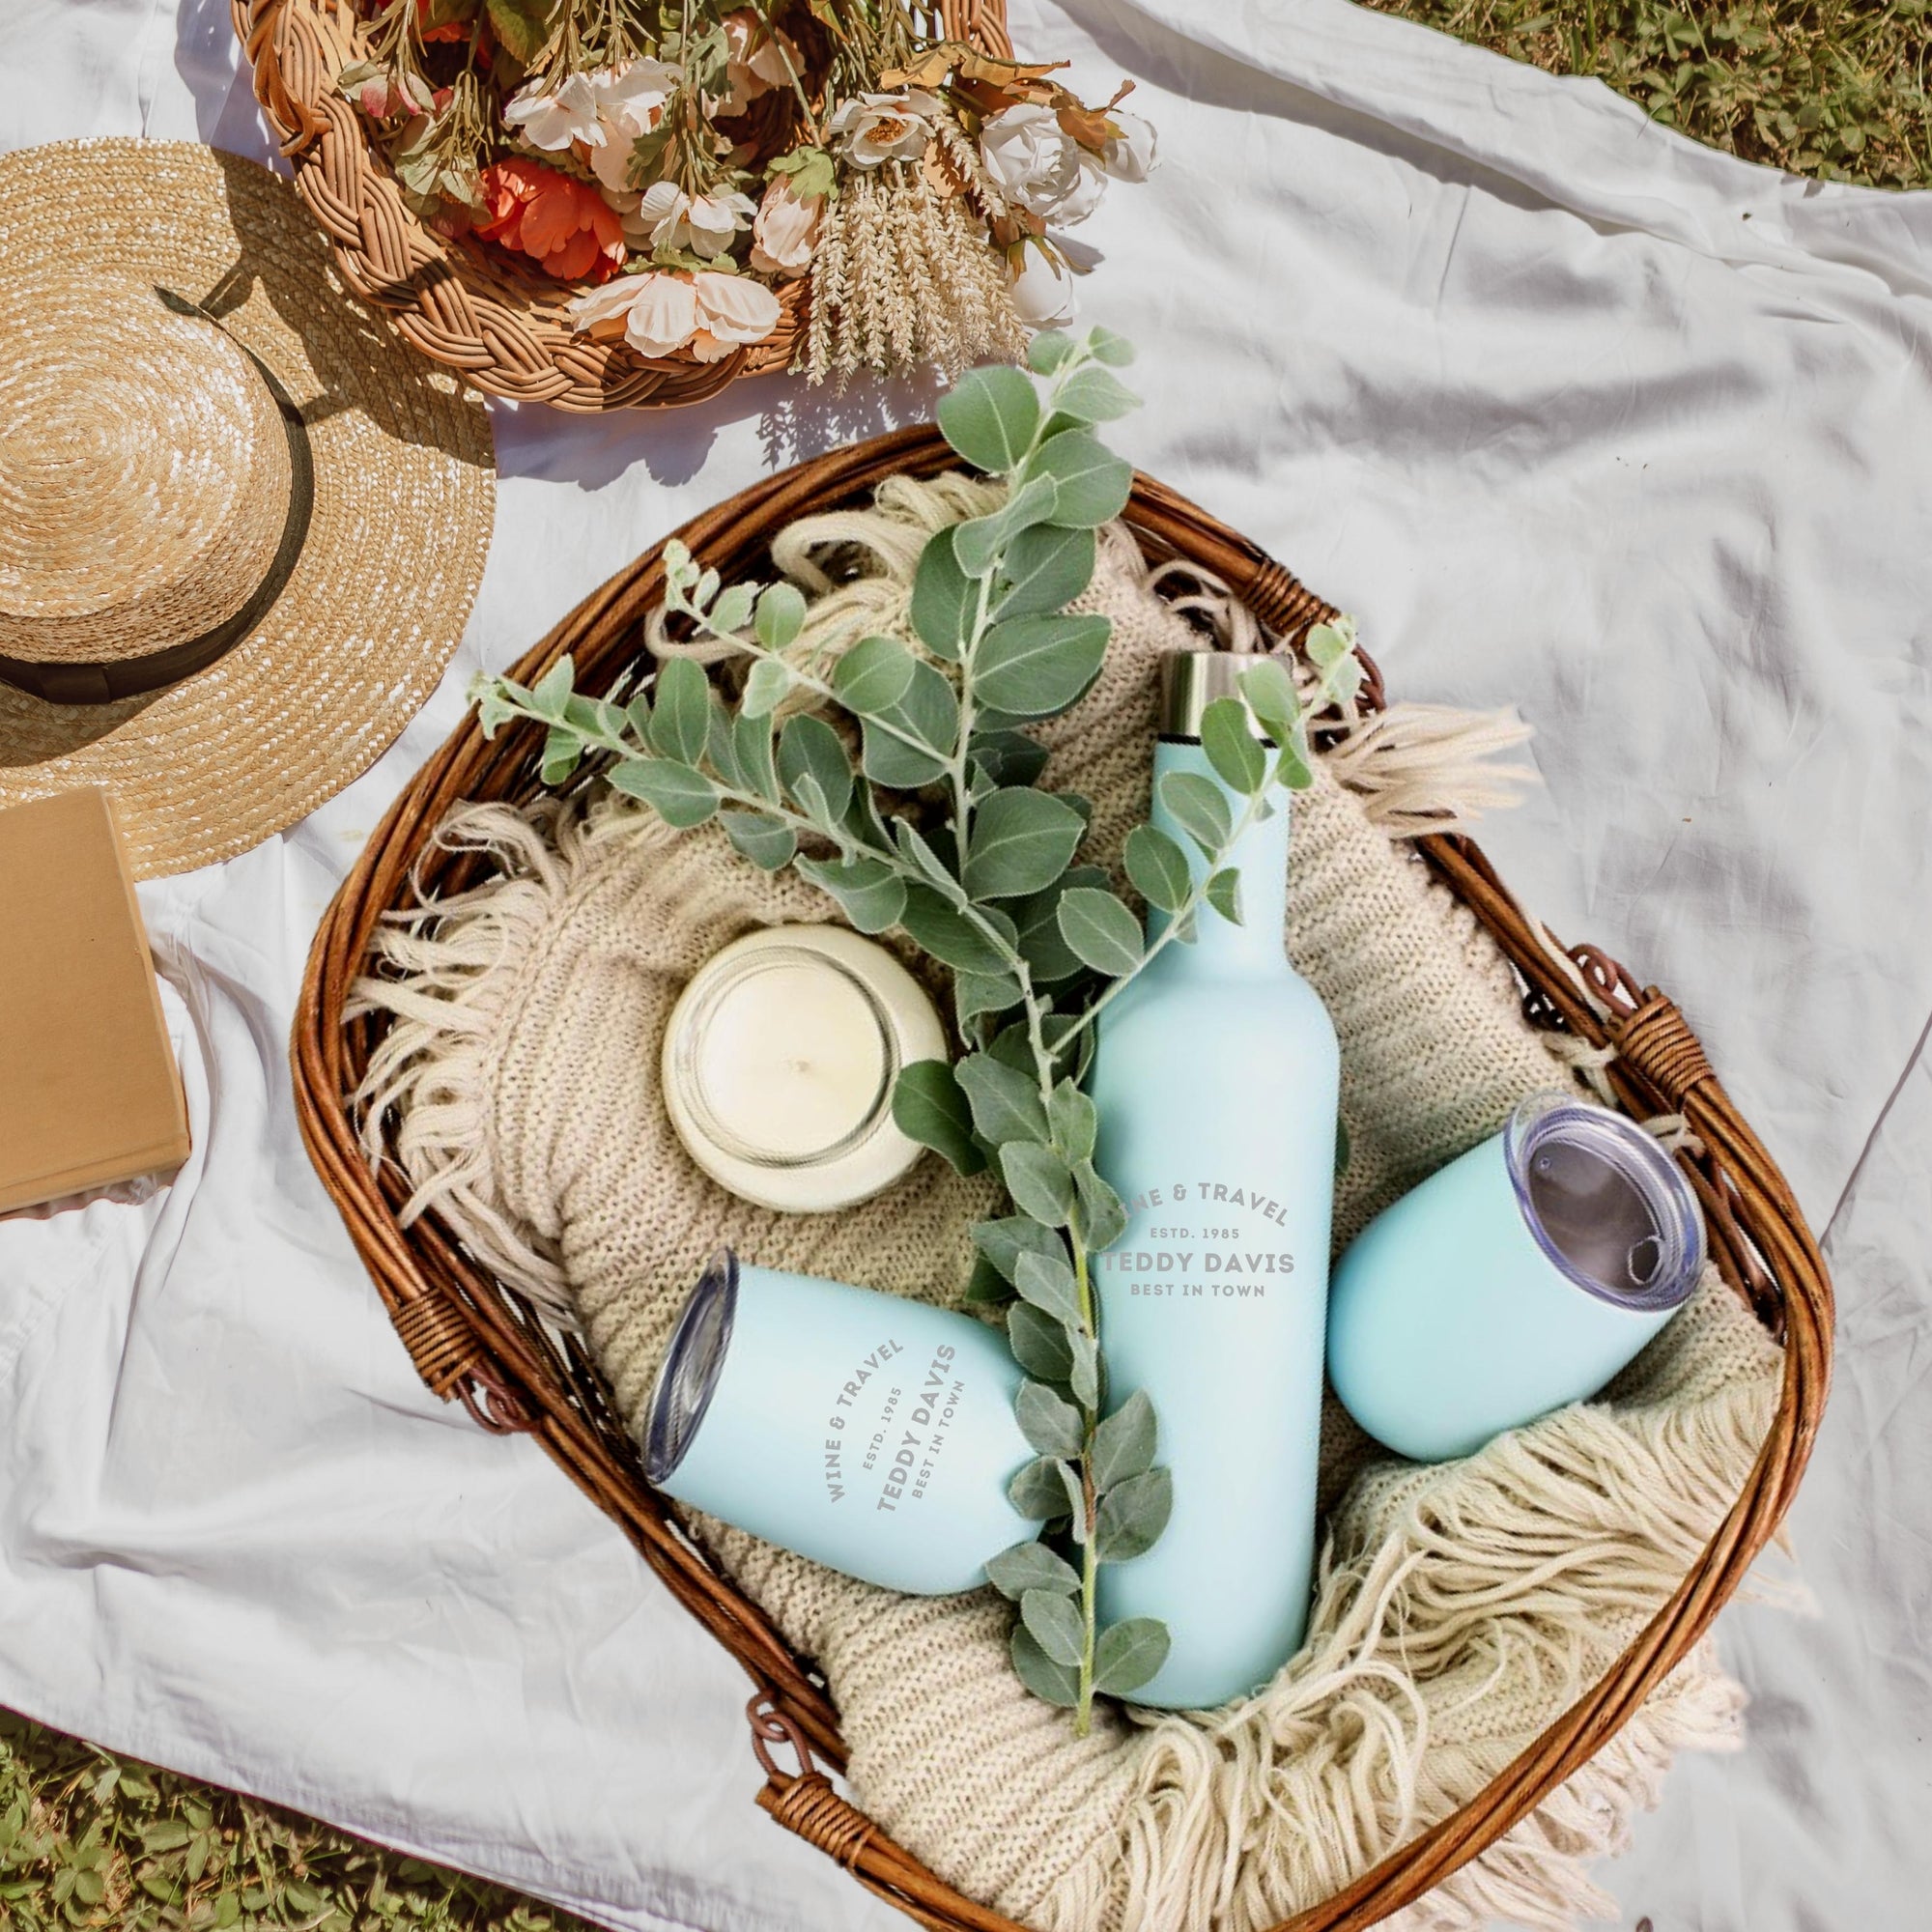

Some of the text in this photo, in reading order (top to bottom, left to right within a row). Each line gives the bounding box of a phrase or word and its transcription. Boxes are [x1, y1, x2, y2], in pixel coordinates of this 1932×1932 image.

[1118, 1182, 1289, 1227] INE & TRAVEL
[1151, 1228, 1239, 1239] ESTD. 1985
[1100, 1252, 1294, 1273] TEDDY DAVIS
[1130, 1284, 1264, 1297] BEST IN TOWN
[825, 1339, 904, 1503] WINE & TRAVEL
[863, 1387, 901, 1470] ESTD. 1985
[876, 1344, 955, 1511] TEDDY DAVIS
[911, 1380, 965, 1499] BEST IN TOWN
